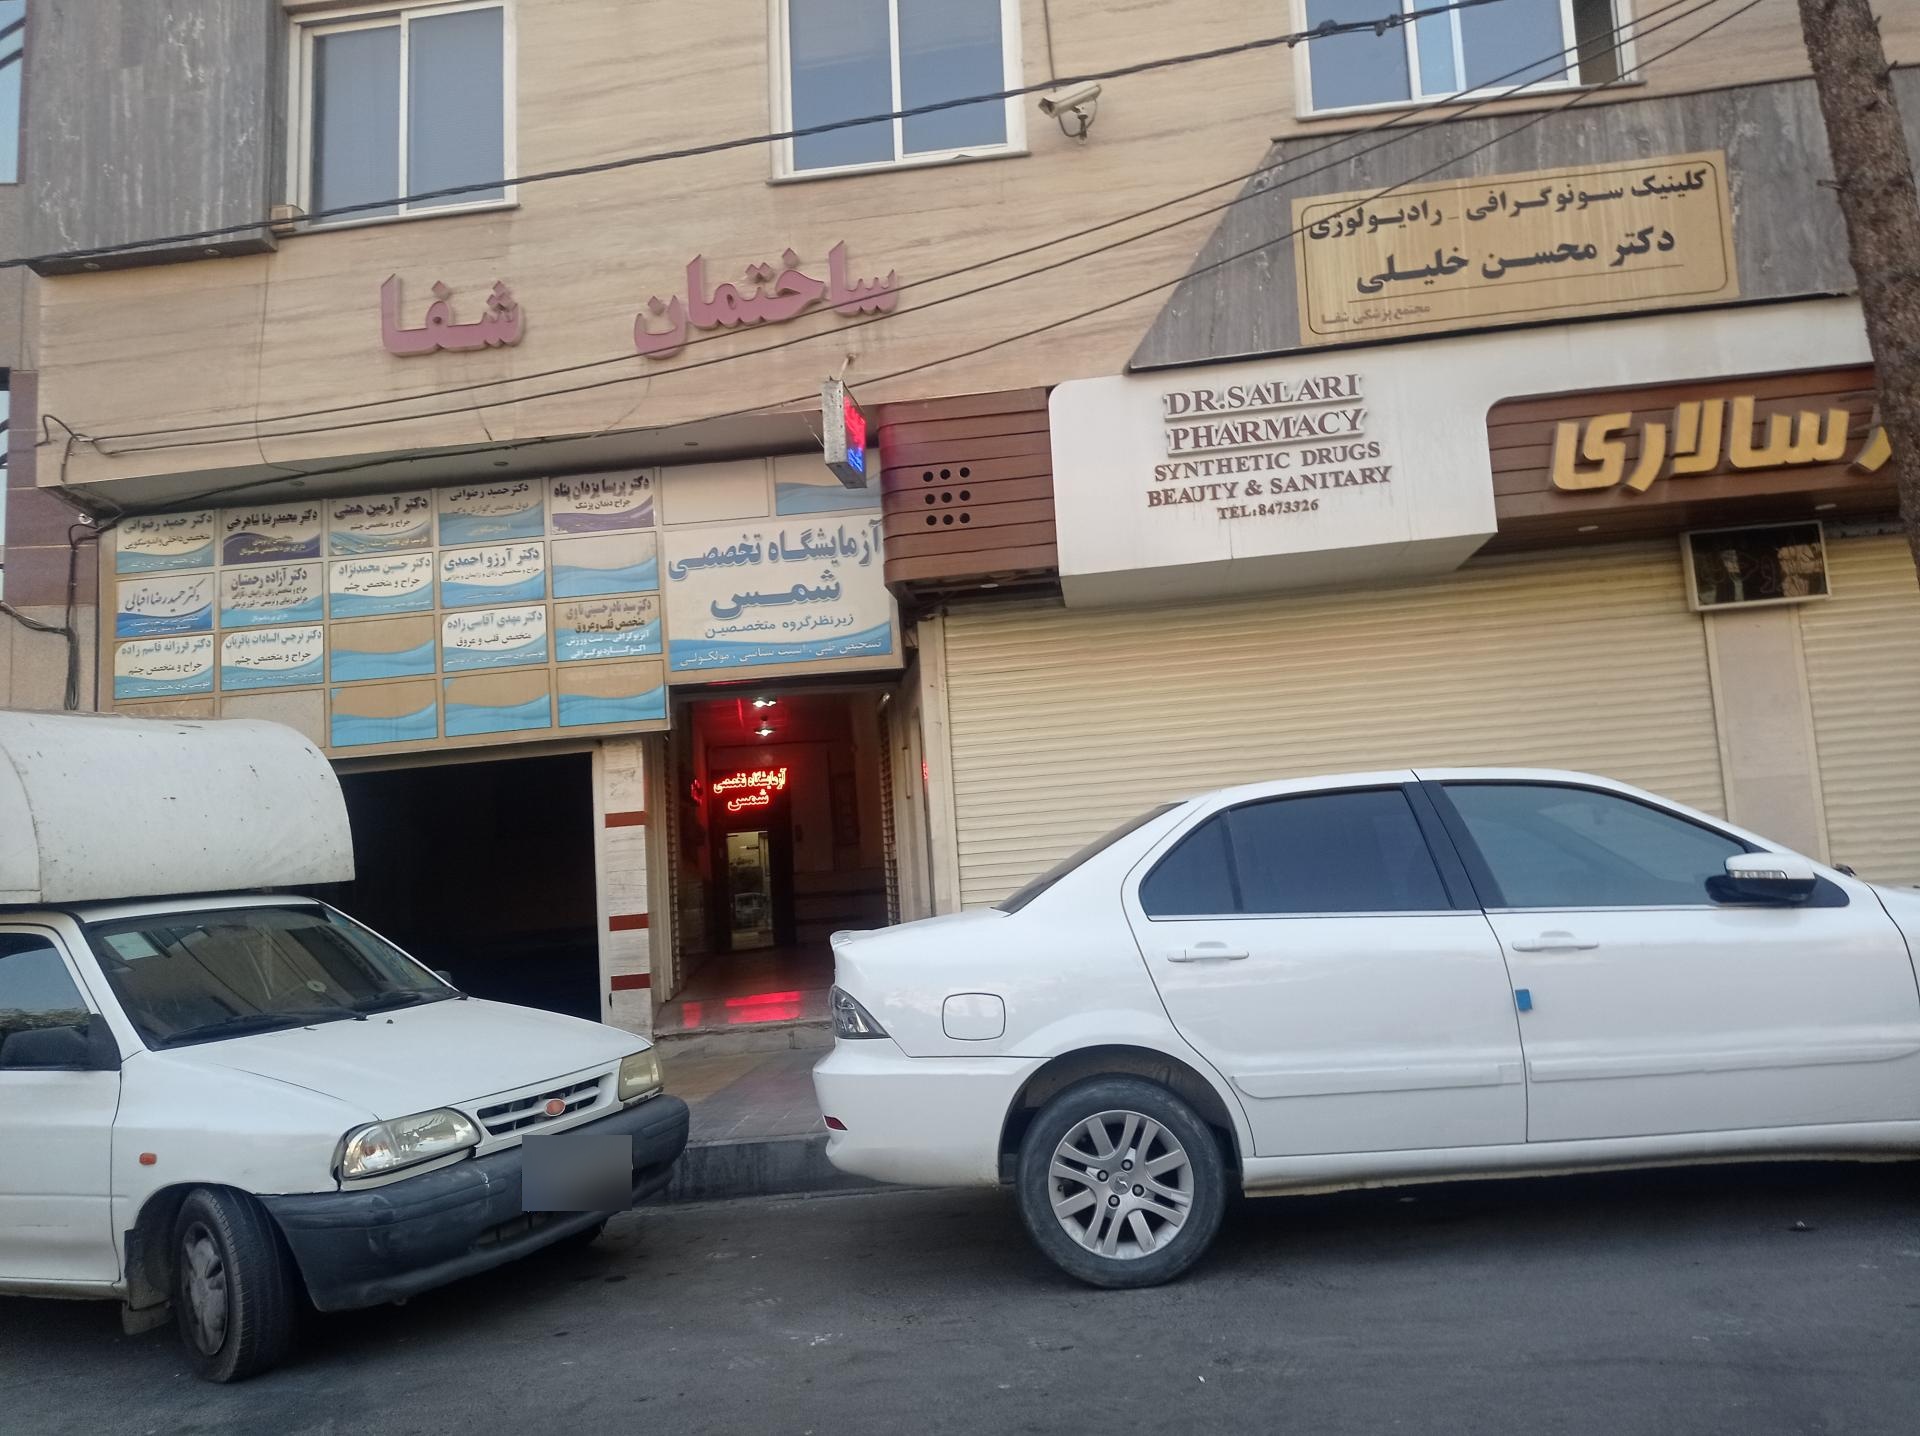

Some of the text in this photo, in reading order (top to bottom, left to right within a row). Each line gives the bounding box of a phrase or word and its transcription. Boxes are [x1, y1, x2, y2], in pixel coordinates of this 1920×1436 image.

[1631, 169, 1707, 200] کلینیک
[1466, 184, 1624, 222] سونوگرافی
[1309, 200, 1443, 240] رادیولوژی
[1356, 225, 1676, 294] دکتر محسن خلیلی
[380, 239, 898, 359] ساختمان شفا
[1320, 311, 1350, 325] شفا
[1167, 374, 1362, 415] DR.SALARI
[1170, 408, 1366, 450] PHARMACY
[1552, 395, 1850, 493] سالاری
[1154, 441, 1381, 482] SYNTHETIC DRUGS
[449, 483, 529, 501] دکتر حمید رضوانی
[628, 475, 650, 496] دکتر
[1147, 465, 1393, 508] BEAUTY & SANITARY
[366, 496, 400, 518] آرمین
[404, 496, 427, 514] دکتر
[1217, 498, 1320, 520] TEL:8473326
[162, 518, 187, 530] حمید
[190, 513, 212, 529] دکتر
[298, 508, 318, 526] دکتر
[668, 519, 883, 581] آزمایشگاه تخصصی
[411, 557, 431, 573] دکتر
[443, 547, 540, 571] دکتر آرزو احمدی
[288, 567, 307, 586] دکتر
[382, 561, 408, 575] حسین
[265, 567, 287, 587] آزاده
[401, 578, 420, 588] جراح
[182, 577, 207, 606] دکتر
[344, 583, 361, 593] چشم
[361, 582, 392, 592] متخصص
[710, 569, 842, 620] شمس
[125, 585, 150, 612] اقبالی
[636, 598, 651, 615] دکتر
[523, 610, 543, 626] دکتر
[600, 619, 614, 629] قلب
[616, 618, 645, 631] متخصص
[576, 622, 595, 633] عروق
[705, 622, 776, 639] متخصصین
[306, 630, 321, 643] دکتر
[456, 637, 476, 647] عروق
[484, 634, 500, 644] قلب
[502, 633, 532, 644] متخصص
[192, 638, 211, 654] دکتر
[234, 655, 252, 666] چشم
[254, 654, 282, 665] متخصص
[291, 651, 311, 662] جراح
[679, 650, 730, 667] مولکولی
[128, 666, 145, 677] چشم
[146, 665, 175, 676] متخصص
[184, 662, 202, 673] جراح
[713, 768, 787, 793] آزمایشگاه تخصصی
[728, 789, 769, 811] شمس
